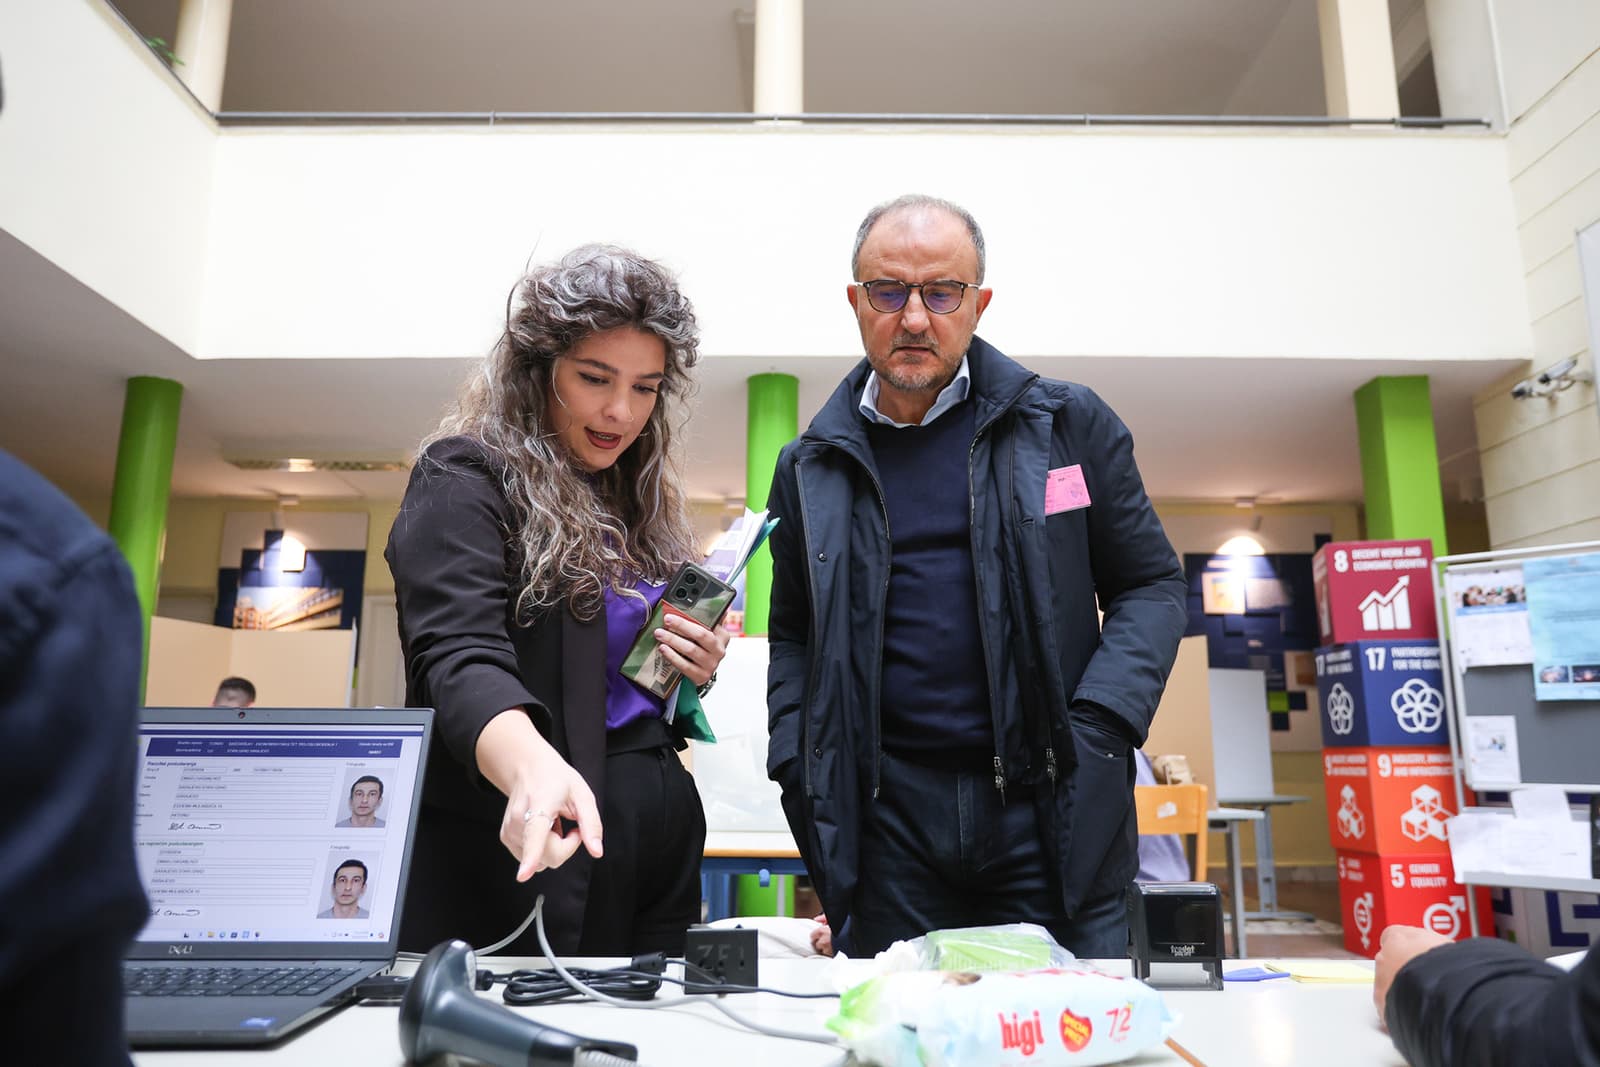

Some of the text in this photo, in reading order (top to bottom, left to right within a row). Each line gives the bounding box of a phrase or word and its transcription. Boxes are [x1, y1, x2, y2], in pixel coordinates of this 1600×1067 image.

[1334, 549, 1349, 573] 8
[1404, 546, 1422, 557] AND
[1393, 557, 1428, 570] GROWTH
[1365, 647, 1386, 671] 17
[1422, 658, 1441, 670] GOAL
[1377, 754, 1392, 777] 9
[1390, 863, 1405, 889] 5
[1408, 863, 1440, 875] GENDER
[1410, 876, 1448, 889] EQUALITY
[998, 1011, 1044, 1056] higi
[1106, 1007, 1131, 1038] 72
